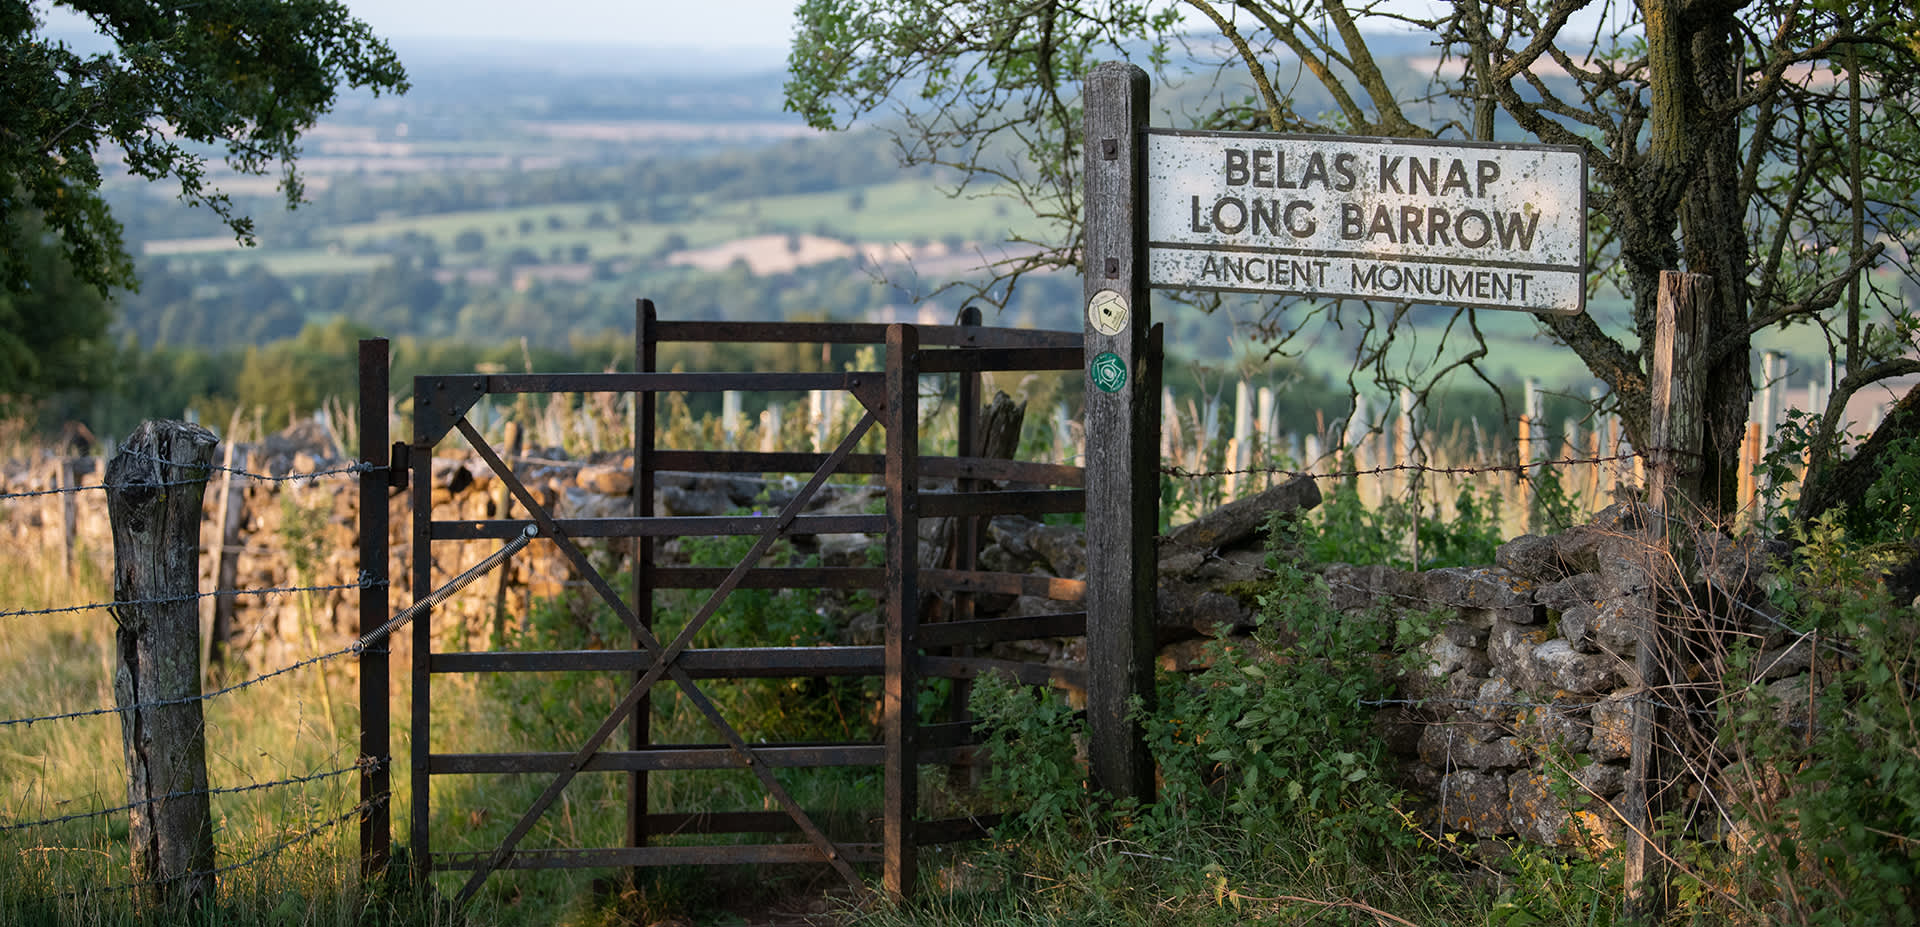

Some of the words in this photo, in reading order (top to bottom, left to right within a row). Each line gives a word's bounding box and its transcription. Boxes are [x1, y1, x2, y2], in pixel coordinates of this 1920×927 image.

[1225, 149, 1357, 192] BELAS
[1378, 155, 1501, 198] KNAP
[1191, 195, 1316, 239] LONG
[1340, 203, 1541, 251] BARROW
[1201, 256, 1330, 287] ANCIENT
[1351, 263, 1534, 300] MONUMENT
